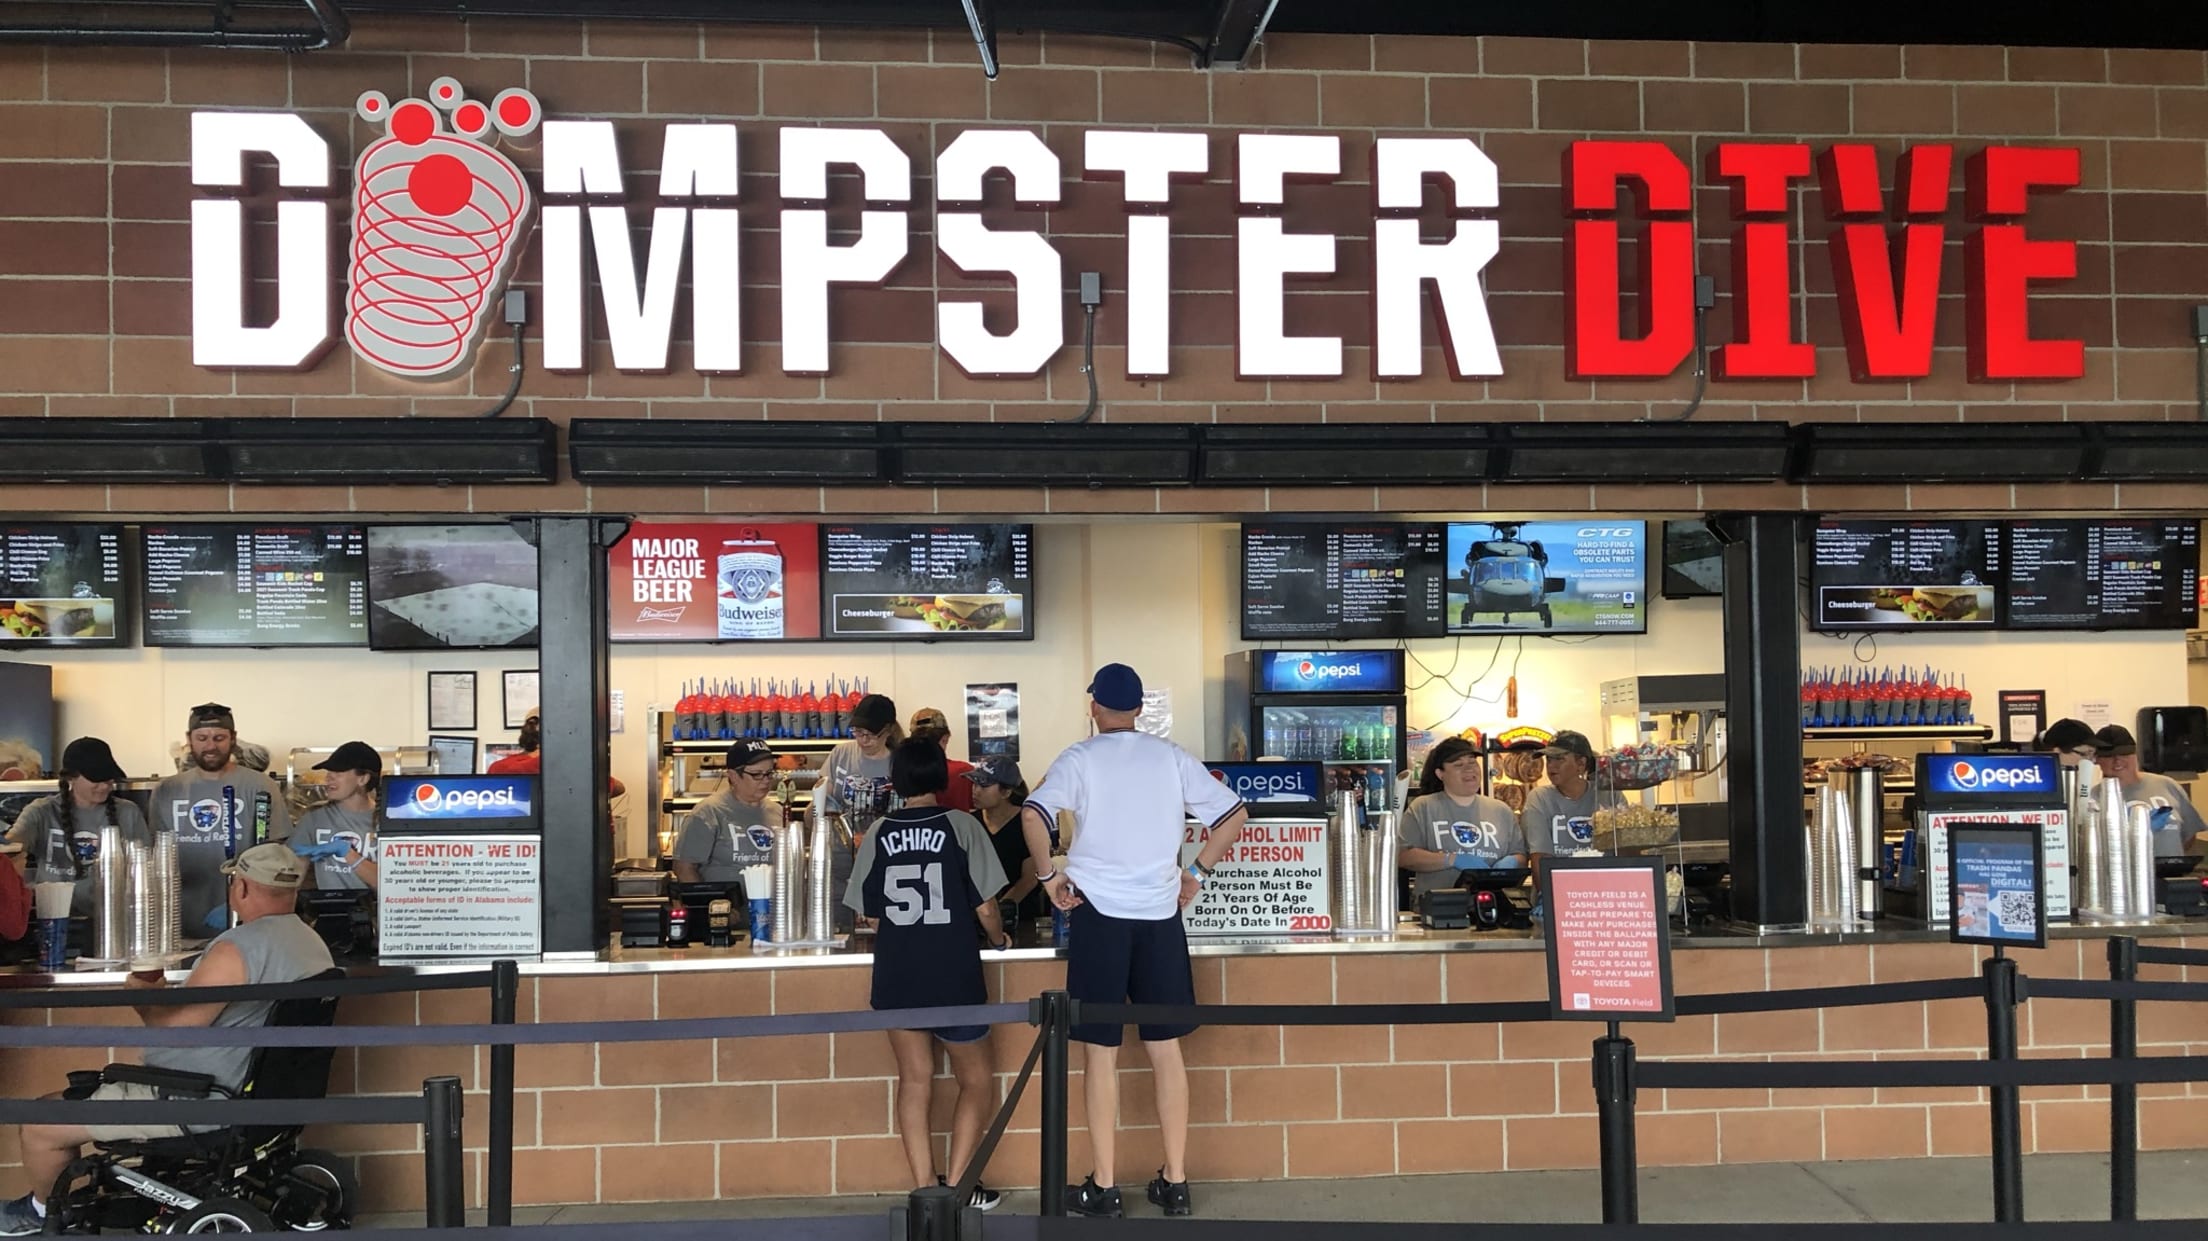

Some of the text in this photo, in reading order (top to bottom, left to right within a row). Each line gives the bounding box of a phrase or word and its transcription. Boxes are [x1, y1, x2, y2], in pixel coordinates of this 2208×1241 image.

[1566, 142, 2086, 380] DIVE
[1577, 528, 1633, 537] CTG
[632, 538, 699, 558] MAJOR
[632, 559, 706, 579] LEAGUE
[633, 580, 693, 603] BEER
[1828, 600, 1876, 611] Cheeseburger
[842, 609, 895, 619] Cheeseburger
[1318, 663, 1361, 679] pepsi
[1982, 765, 2042, 787] pepsi
[1237, 772, 1302, 797] pepsi
[445, 787, 516, 810] pepsi
[2047, 813, 2064, 826] ID!
[1186, 828, 1195, 843] 2
[1280, 828, 1322, 843] LIMIT
[881, 828, 946, 857] ICHIRO
[385, 844, 473, 858] ATTENTION
[488, 844, 511, 858] WE
[516, 844, 537, 858] ID!
[1240, 846, 1304, 862] PERSON
[1209, 868, 1322, 878] Purchase Alcohol
[1210, 882, 1255, 891] Person
[1260, 882, 1292, 891] Must
[1296, 882, 1313, 891] Be
[1990, 878, 2032, 887] DIGITAL!
[884, 862, 951, 926] 51
[1202, 894, 1307, 905] 21 Years Of Age
[1566, 891, 1647, 899] TOYOTA FIELD IS A
[1195, 906, 1314, 915] Born On Or Before
[1569, 901, 1614, 909] CASHLESS
[1565, 911, 1653, 919] PLEASE PREPARE TO
[1187, 916, 1331, 930] Today's Date In 2000
[1563, 930, 1592, 938] INSIDE
[1595, 930, 1612, 938] THE
[1574, 940, 1648, 948] WITH ANY MAJOR
[1575, 950, 1649, 958] CREDIT OR DEBIT
[1572, 960, 1652, 969] CARD, OR SCAN OR
[1571, 970, 1654, 978] TAP-TO-PAY SMART
[1593, 998, 1631, 1006] TOYOTA
[139, 1181, 181, 1207] Jazzy
